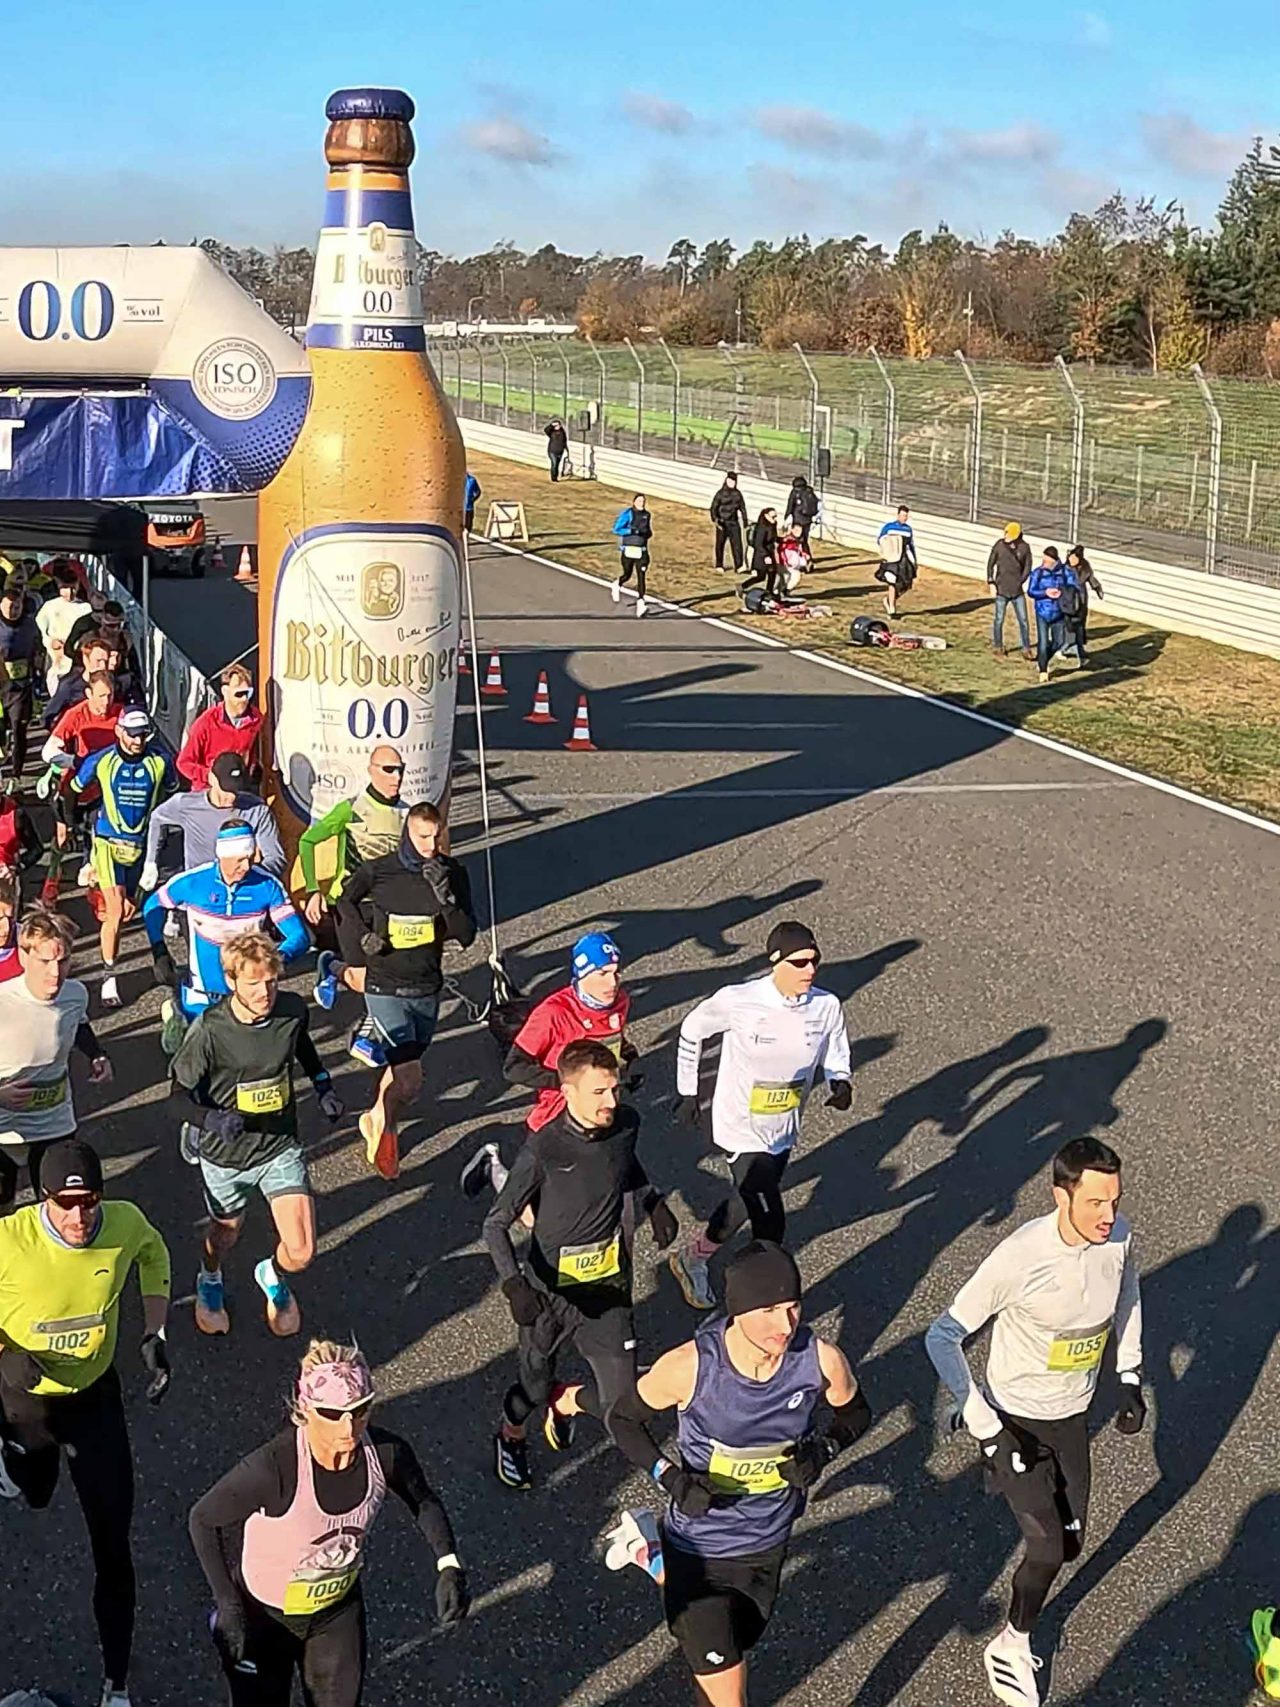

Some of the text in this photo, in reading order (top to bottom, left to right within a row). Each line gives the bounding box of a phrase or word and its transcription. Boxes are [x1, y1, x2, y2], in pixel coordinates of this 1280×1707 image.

[17, 279, 115, 342] 0.0
[363, 290, 392, 314] 0.0
[363, 327, 394, 342] PILS
[214, 362, 257, 386] ISO
[283, 619, 456, 695] Bitburger
[347, 697, 410, 740] 0.0
[48, 1331, 90, 1350] 1002
[1067, 1335, 1102, 1356] 1055
[731, 1460, 777, 1477] 1026
[307, 1575, 351, 1599] 1000
